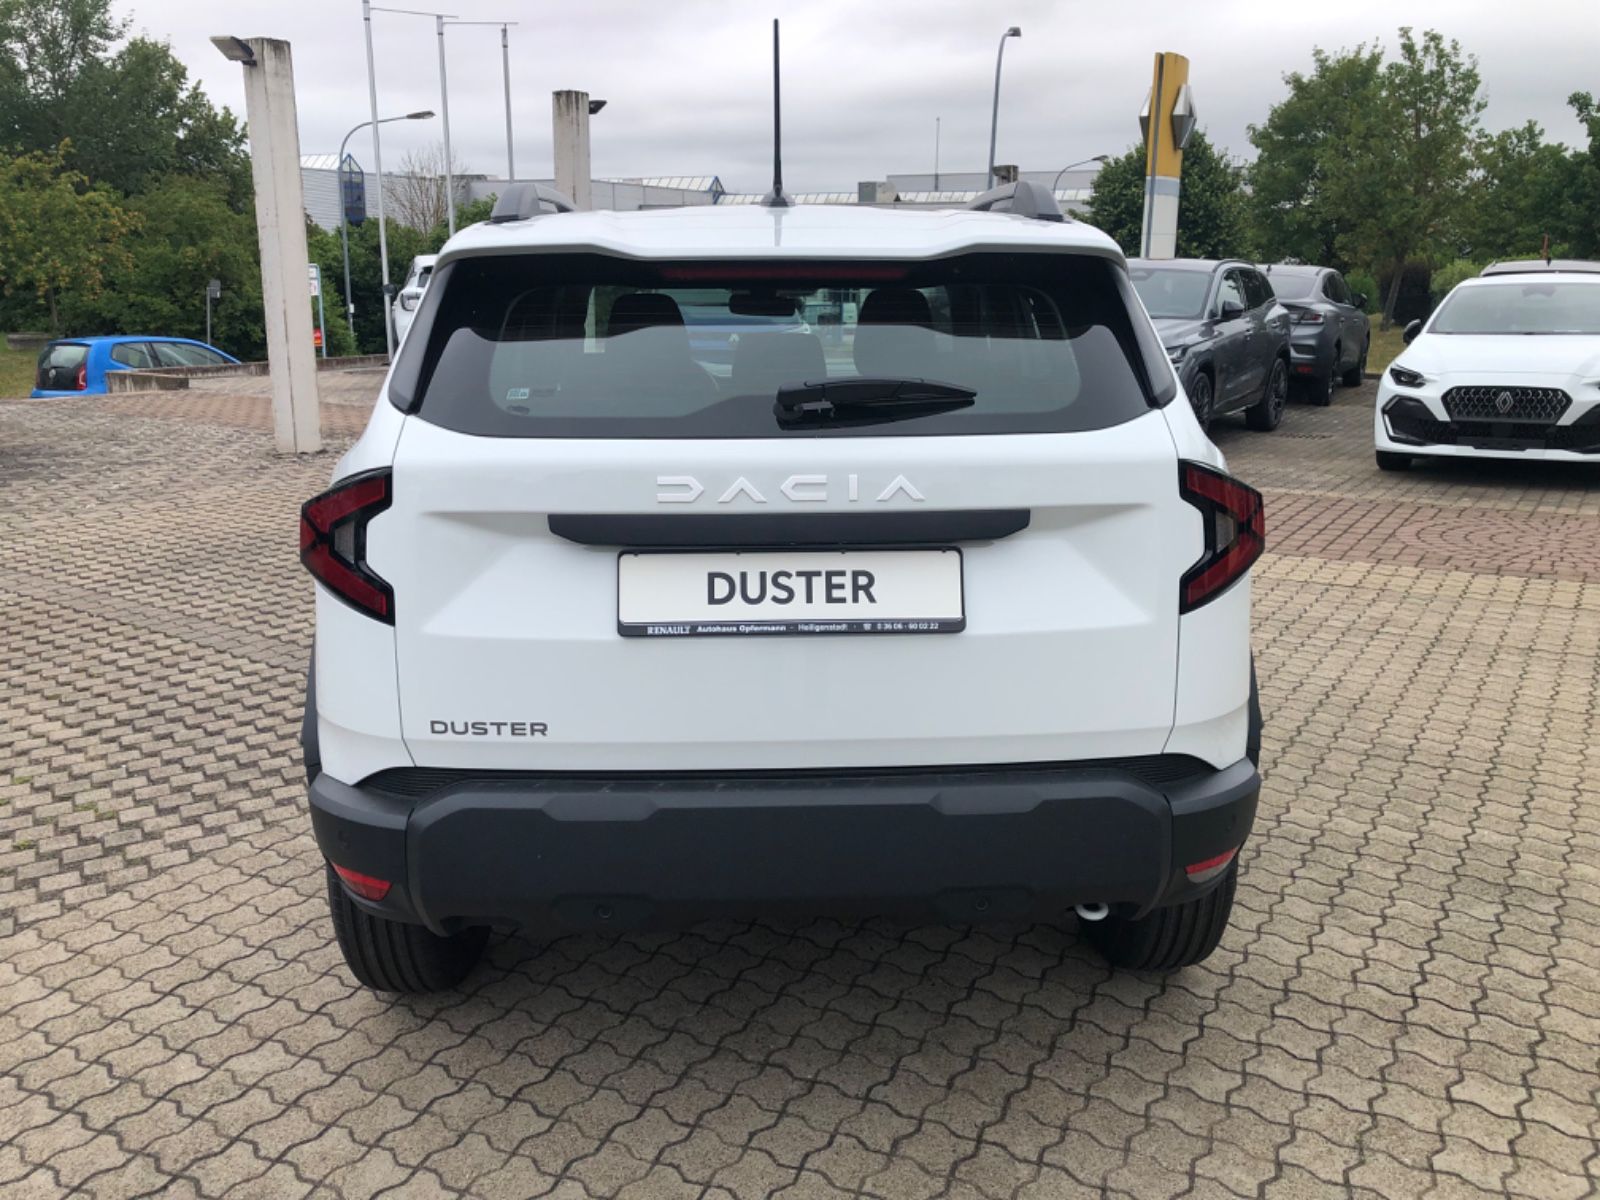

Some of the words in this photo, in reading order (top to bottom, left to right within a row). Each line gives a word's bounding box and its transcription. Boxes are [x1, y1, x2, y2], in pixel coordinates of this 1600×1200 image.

[656, 473, 926, 503] DACIA
[707, 570, 877, 605] DUSTER
[647, 625, 691, 635] RENAULT
[696, 625, 738, 633] Autohaus
[739, 624, 787, 633] Opfermann
[430, 720, 548, 737] DUSTER
